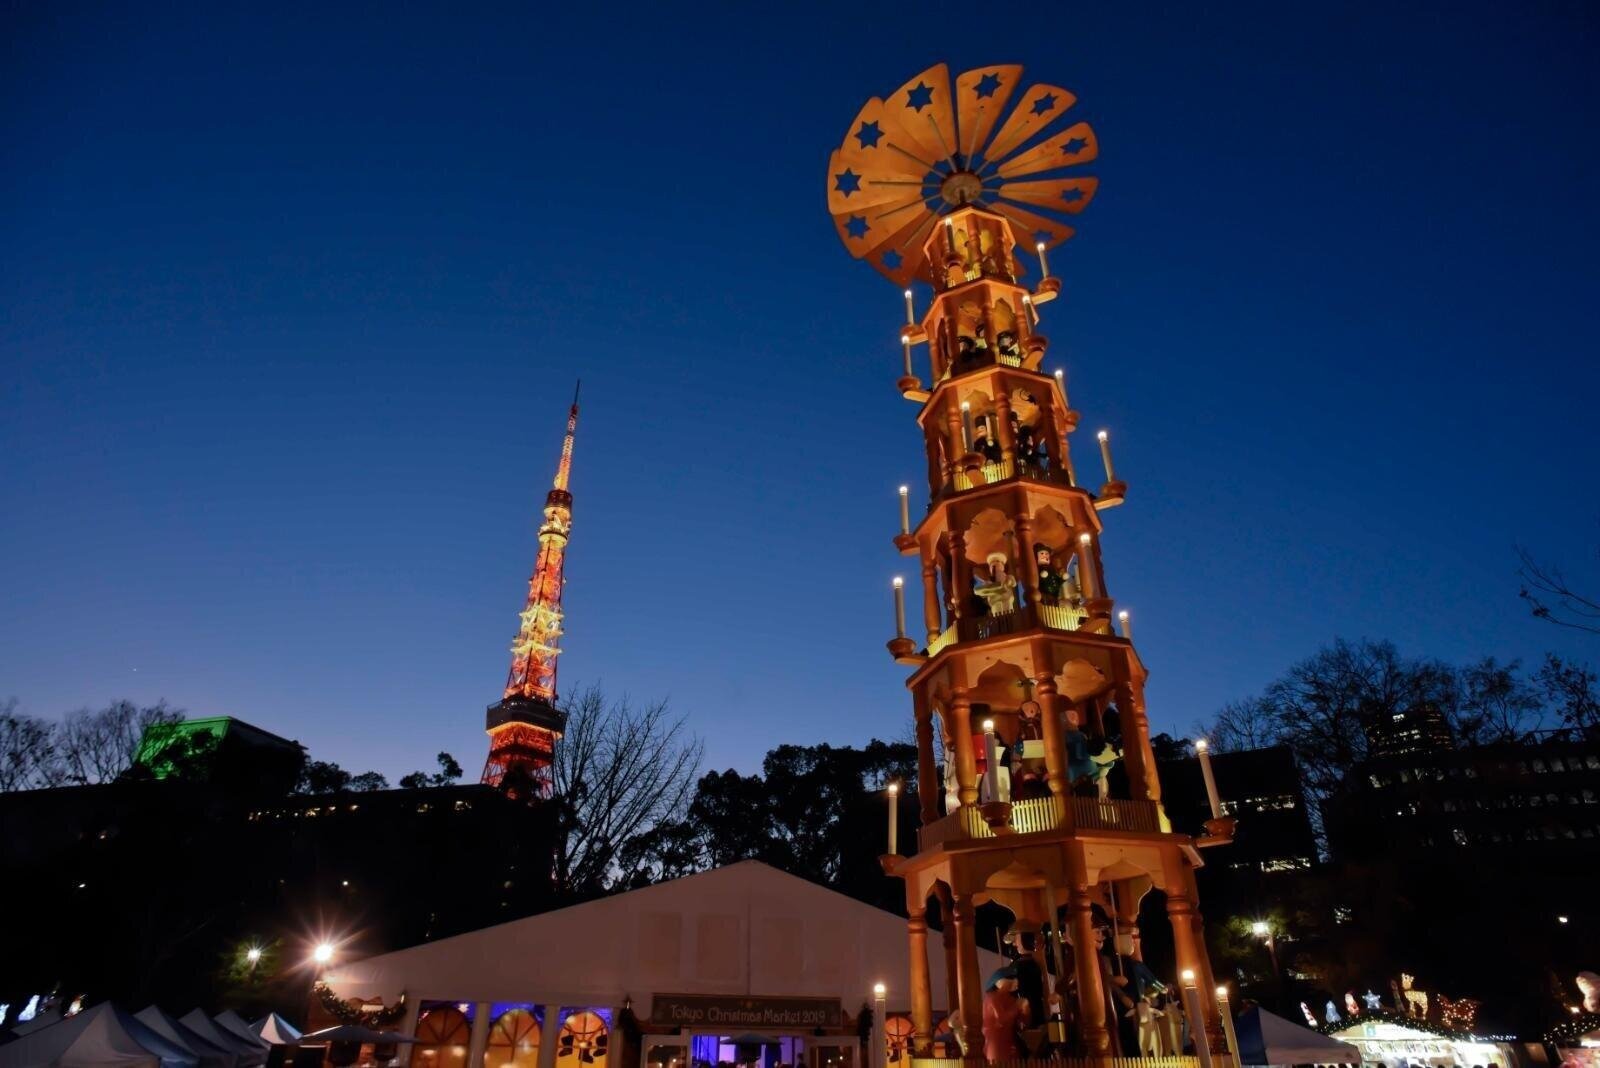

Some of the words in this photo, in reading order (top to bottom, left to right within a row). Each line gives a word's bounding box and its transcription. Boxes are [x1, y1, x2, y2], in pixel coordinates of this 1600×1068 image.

[670, 1005, 704, 1022] Tokyo
[707, 1006, 762, 1023] Christmas
[763, 1008, 800, 1024] Market
[802, 1009, 826, 1024] 2019
